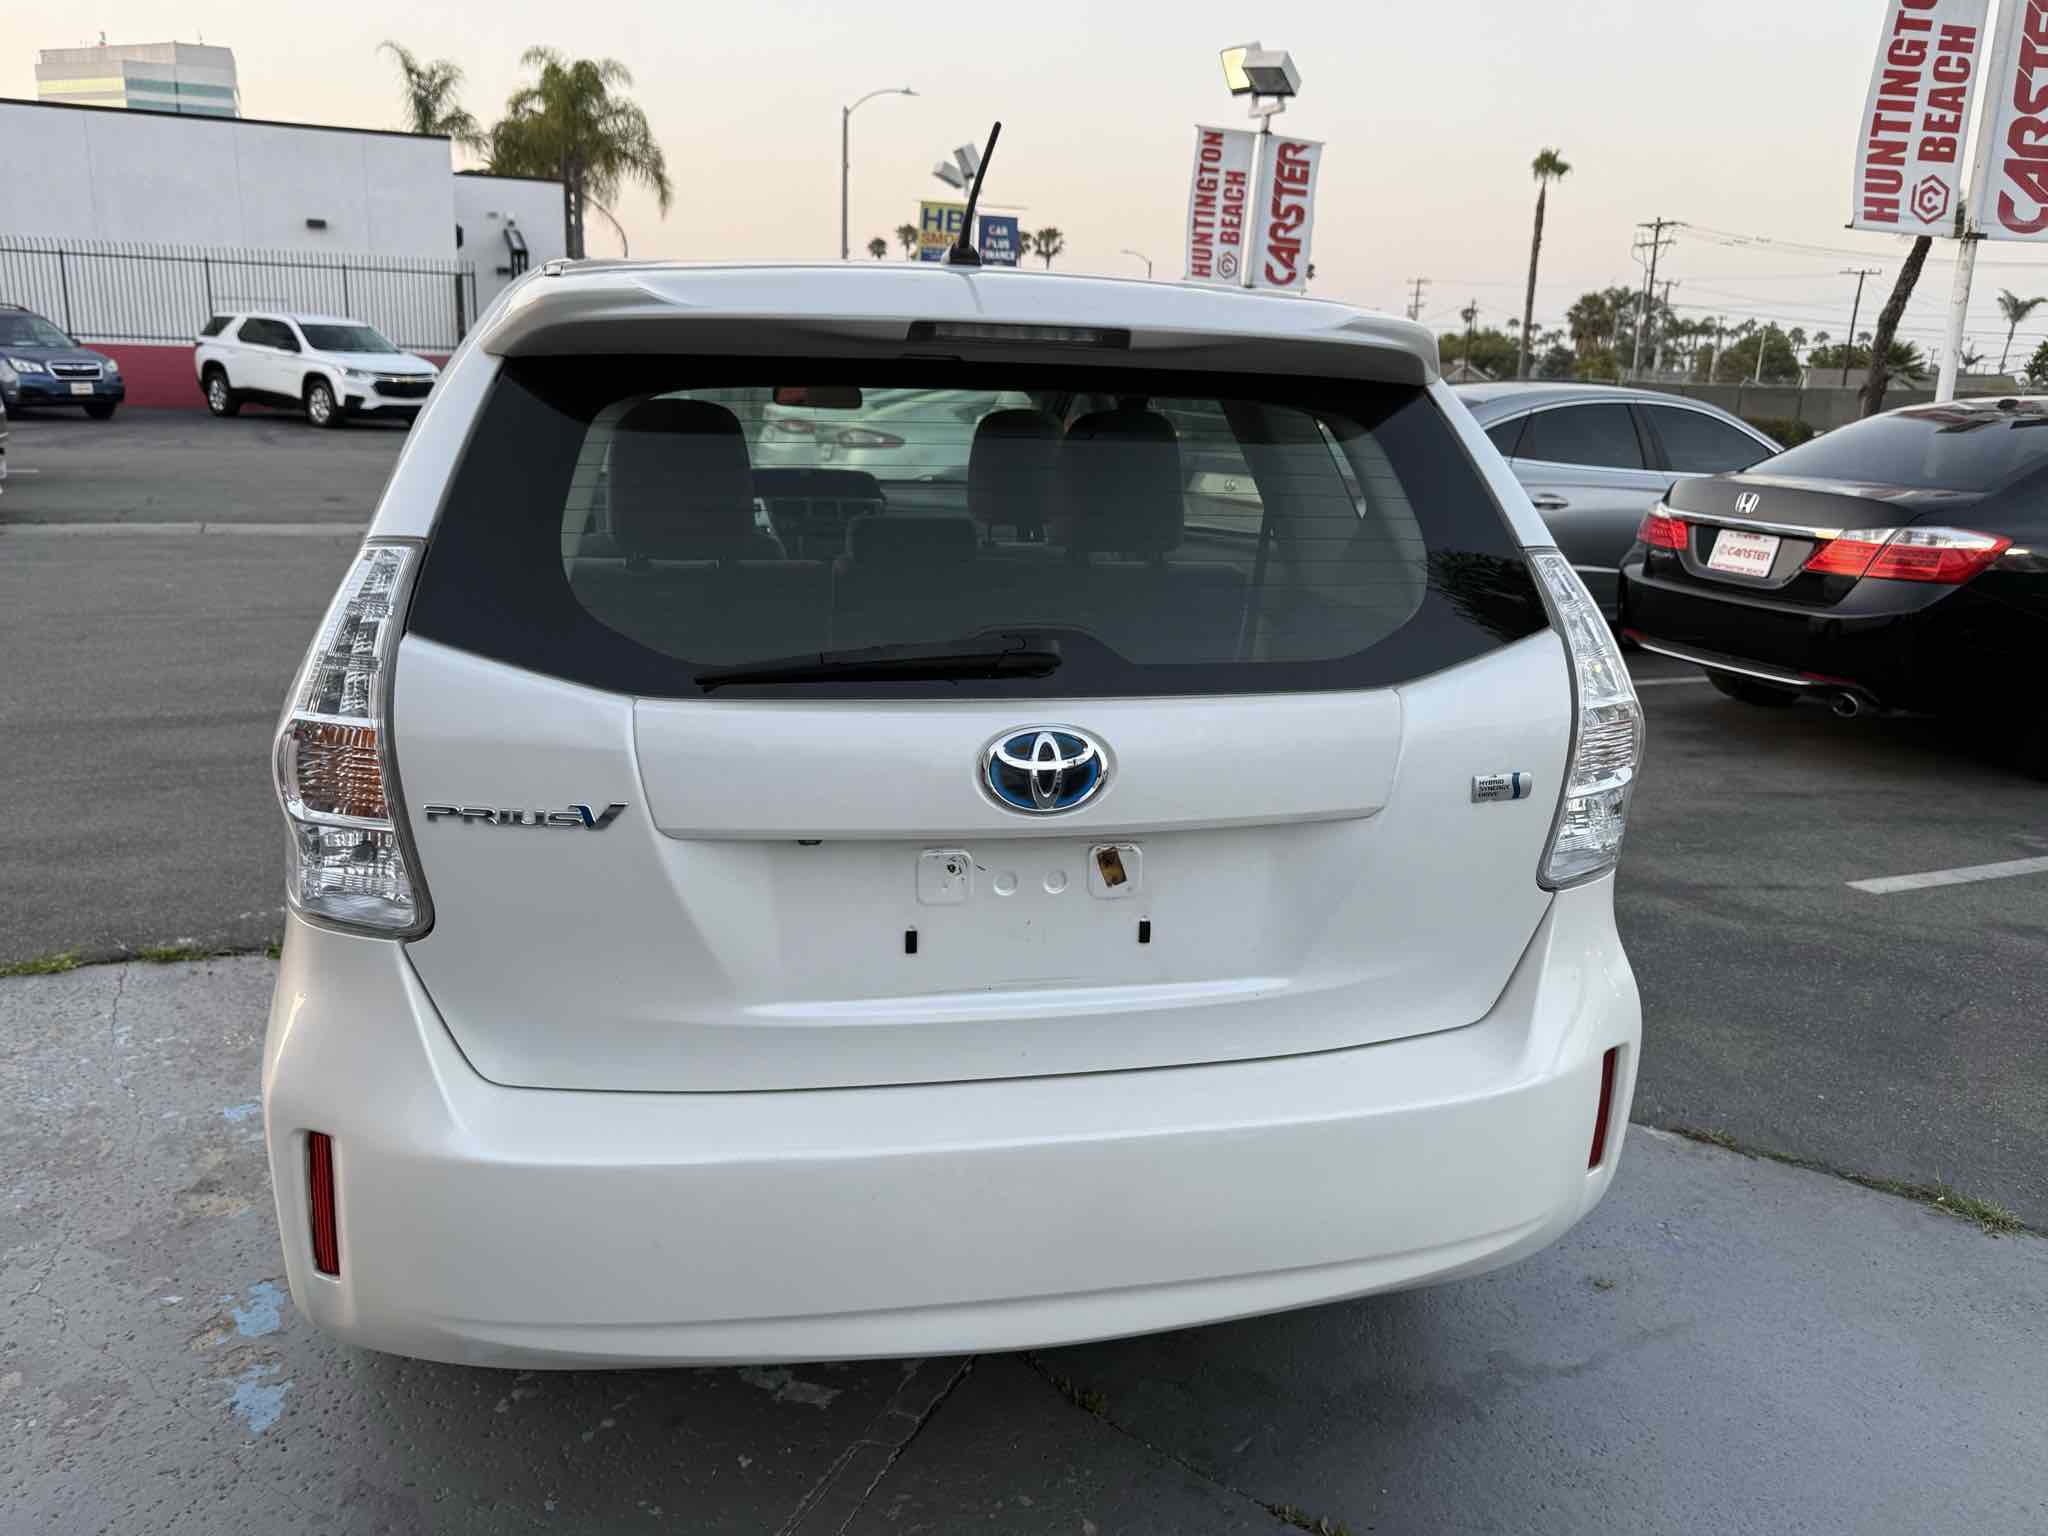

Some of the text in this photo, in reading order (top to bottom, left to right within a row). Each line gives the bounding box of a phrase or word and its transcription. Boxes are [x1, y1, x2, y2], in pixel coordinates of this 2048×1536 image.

[1917, 24, 1977, 163] BEACH
[1192, 130, 1224, 277] HUNTINGTON
[1220, 170, 1246, 245] BEACH
[1265, 142, 1311, 285] CARSTER
